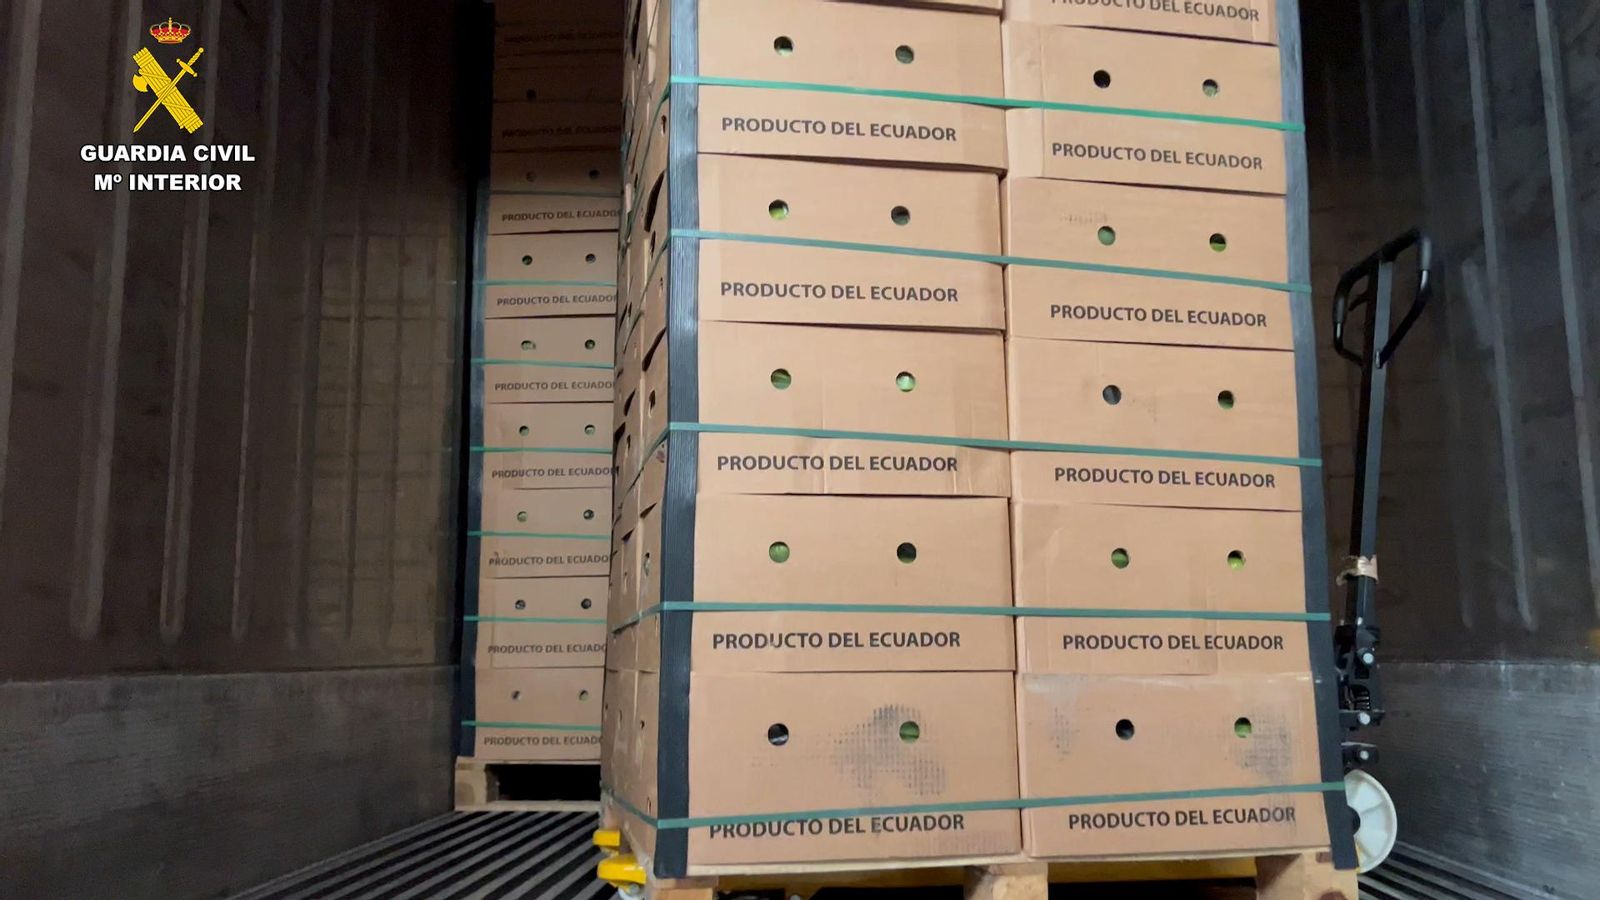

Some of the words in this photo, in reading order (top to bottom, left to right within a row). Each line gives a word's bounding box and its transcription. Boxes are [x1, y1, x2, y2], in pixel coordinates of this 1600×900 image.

[1150, 0, 1179, 13] DEL
[1184, 4, 1260, 21] ECUADOR
[722, 117, 827, 135] PRODUCTO
[831, 121, 866, 137] DEL
[870, 123, 957, 141] ECUADOR
[1052, 142, 1145, 161] PRODUCTO
[1150, 148, 1181, 164] DEL
[1186, 152, 1263, 170] ECUADOR
[502, 211, 554, 221] PRODUCTO
[557, 211, 573, 219] DEL
[577, 210, 618, 218] ECUADO
[497, 296, 549, 305] PRODUCTO
[552, 295, 570, 304] DEL
[721, 282, 826, 299] PRODUCTO
[832, 285, 866, 300] DEL
[871, 286, 958, 302] ECUADOR
[1051, 304, 1147, 321] PRODUCTO
[1152, 308, 1183, 323] DEL
[1188, 310, 1267, 327] ECUADOR
[495, 381, 547, 391] PRODUCTO
[551, 381, 568, 390] DEL
[717, 455, 824, 471] PRODUCTO
[829, 456, 865, 470] DEL
[870, 456, 957, 471] ECUADOR
[492, 468, 545, 478] PRODUCTO
[548, 468, 565, 476] DEL
[1055, 467, 1154, 485] PRODUCTO
[1158, 470, 1191, 486] DEL
[1195, 471, 1275, 489] ECUADOR
[489, 556, 543, 565] PRODUCTO
[546, 555, 563, 564] DEL
[568, 555, 608, 563] ECUADO
[713, 632, 823, 649] PRODUCTO
[828, 632, 865, 648] DEL
[870, 632, 960, 647] ECUADOR
[1063, 635, 1163, 650] PRODUCTO
[1168, 635, 1200, 650] DEL
[1205, 635, 1283, 650] ECUADOR
[488, 645, 542, 654] PRODUCTO
[484, 737, 539, 746] PRODUCTO
[543, 737, 560, 745] DEL
[1069, 812, 1170, 829] PRODUCTO
[1176, 810, 1208, 825] DEL
[1214, 807, 1295, 824] ECUADOR
[710, 819, 822, 839] PRODUCTO
[829, 817, 865, 835] DEL
[872, 814, 964, 833] ECUADOR
